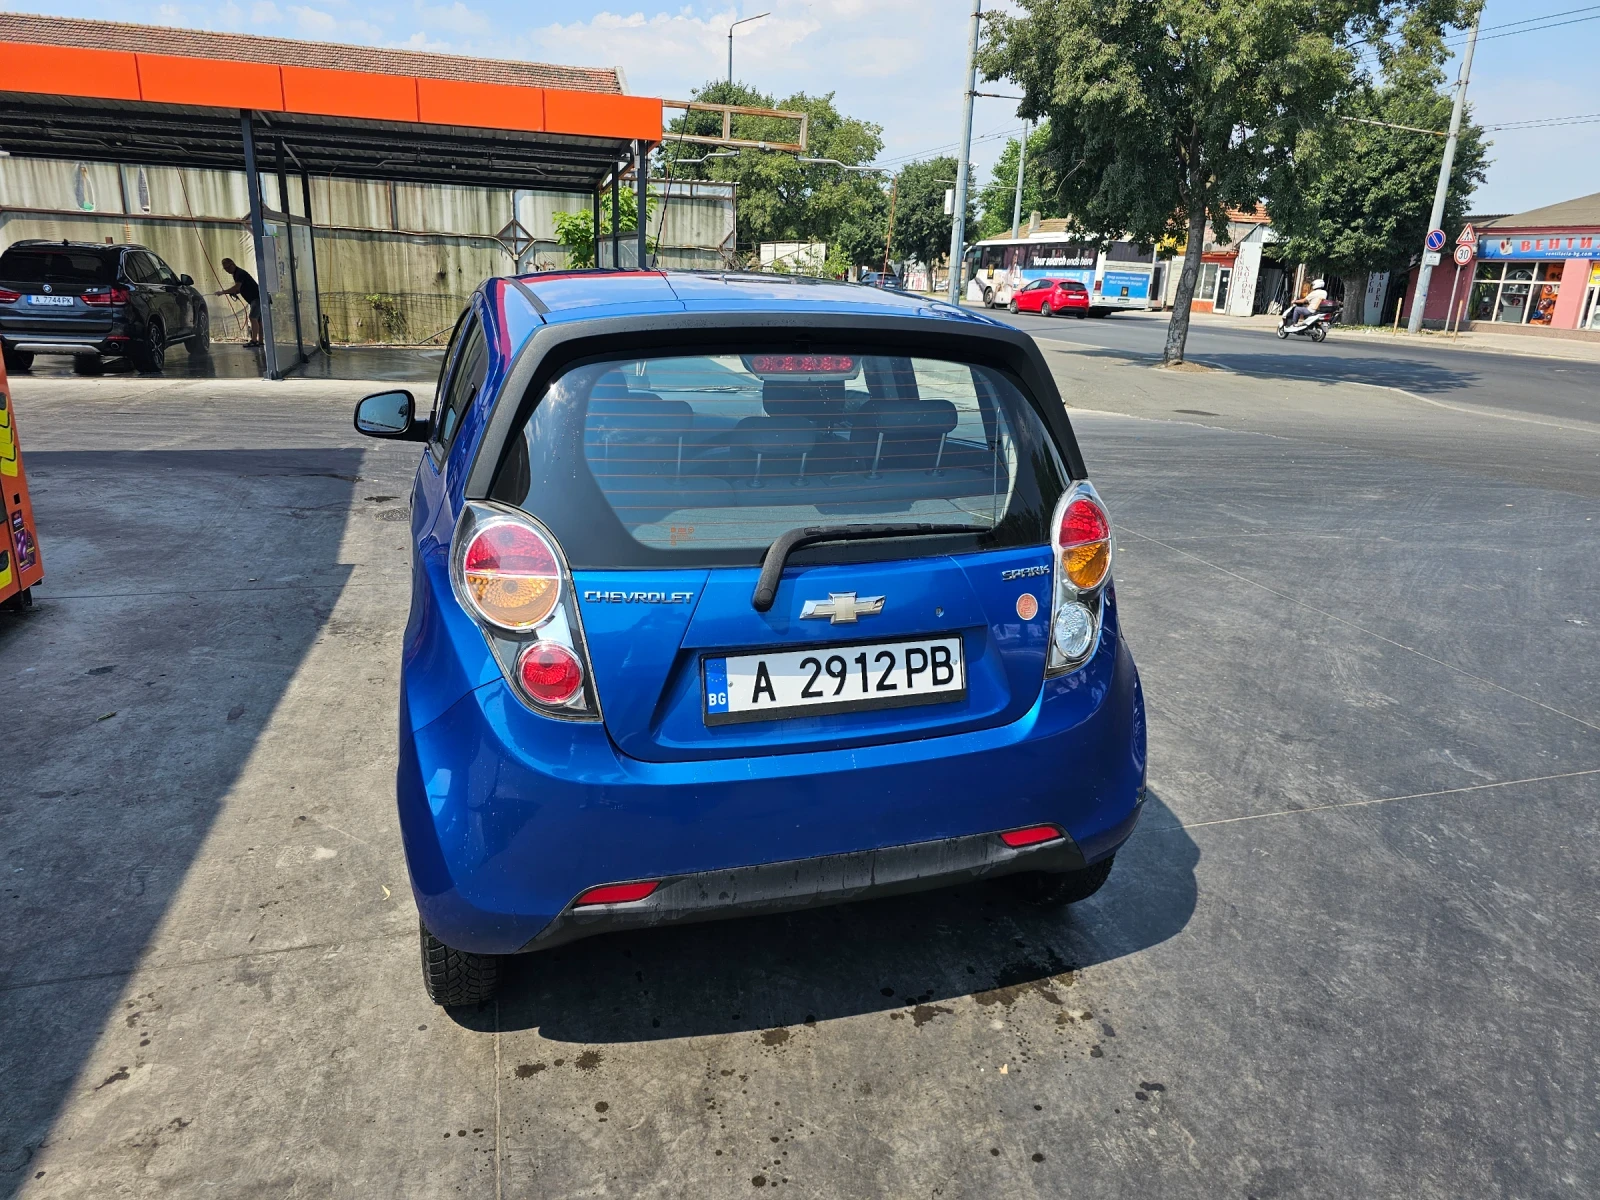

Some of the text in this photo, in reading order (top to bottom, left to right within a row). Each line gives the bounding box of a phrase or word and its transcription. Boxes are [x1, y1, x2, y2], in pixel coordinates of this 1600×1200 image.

[1520, 236, 1600, 253] ВЕНТИ
[1033, 255, 1094, 266] Your search ends here
[1458, 249, 1470, 260] 30
[1001, 564, 1051, 581] SPARK
[584, 590, 695, 604] CHEVROLET
[751, 661, 777, 703] A
[708, 692, 727, 706] BG
